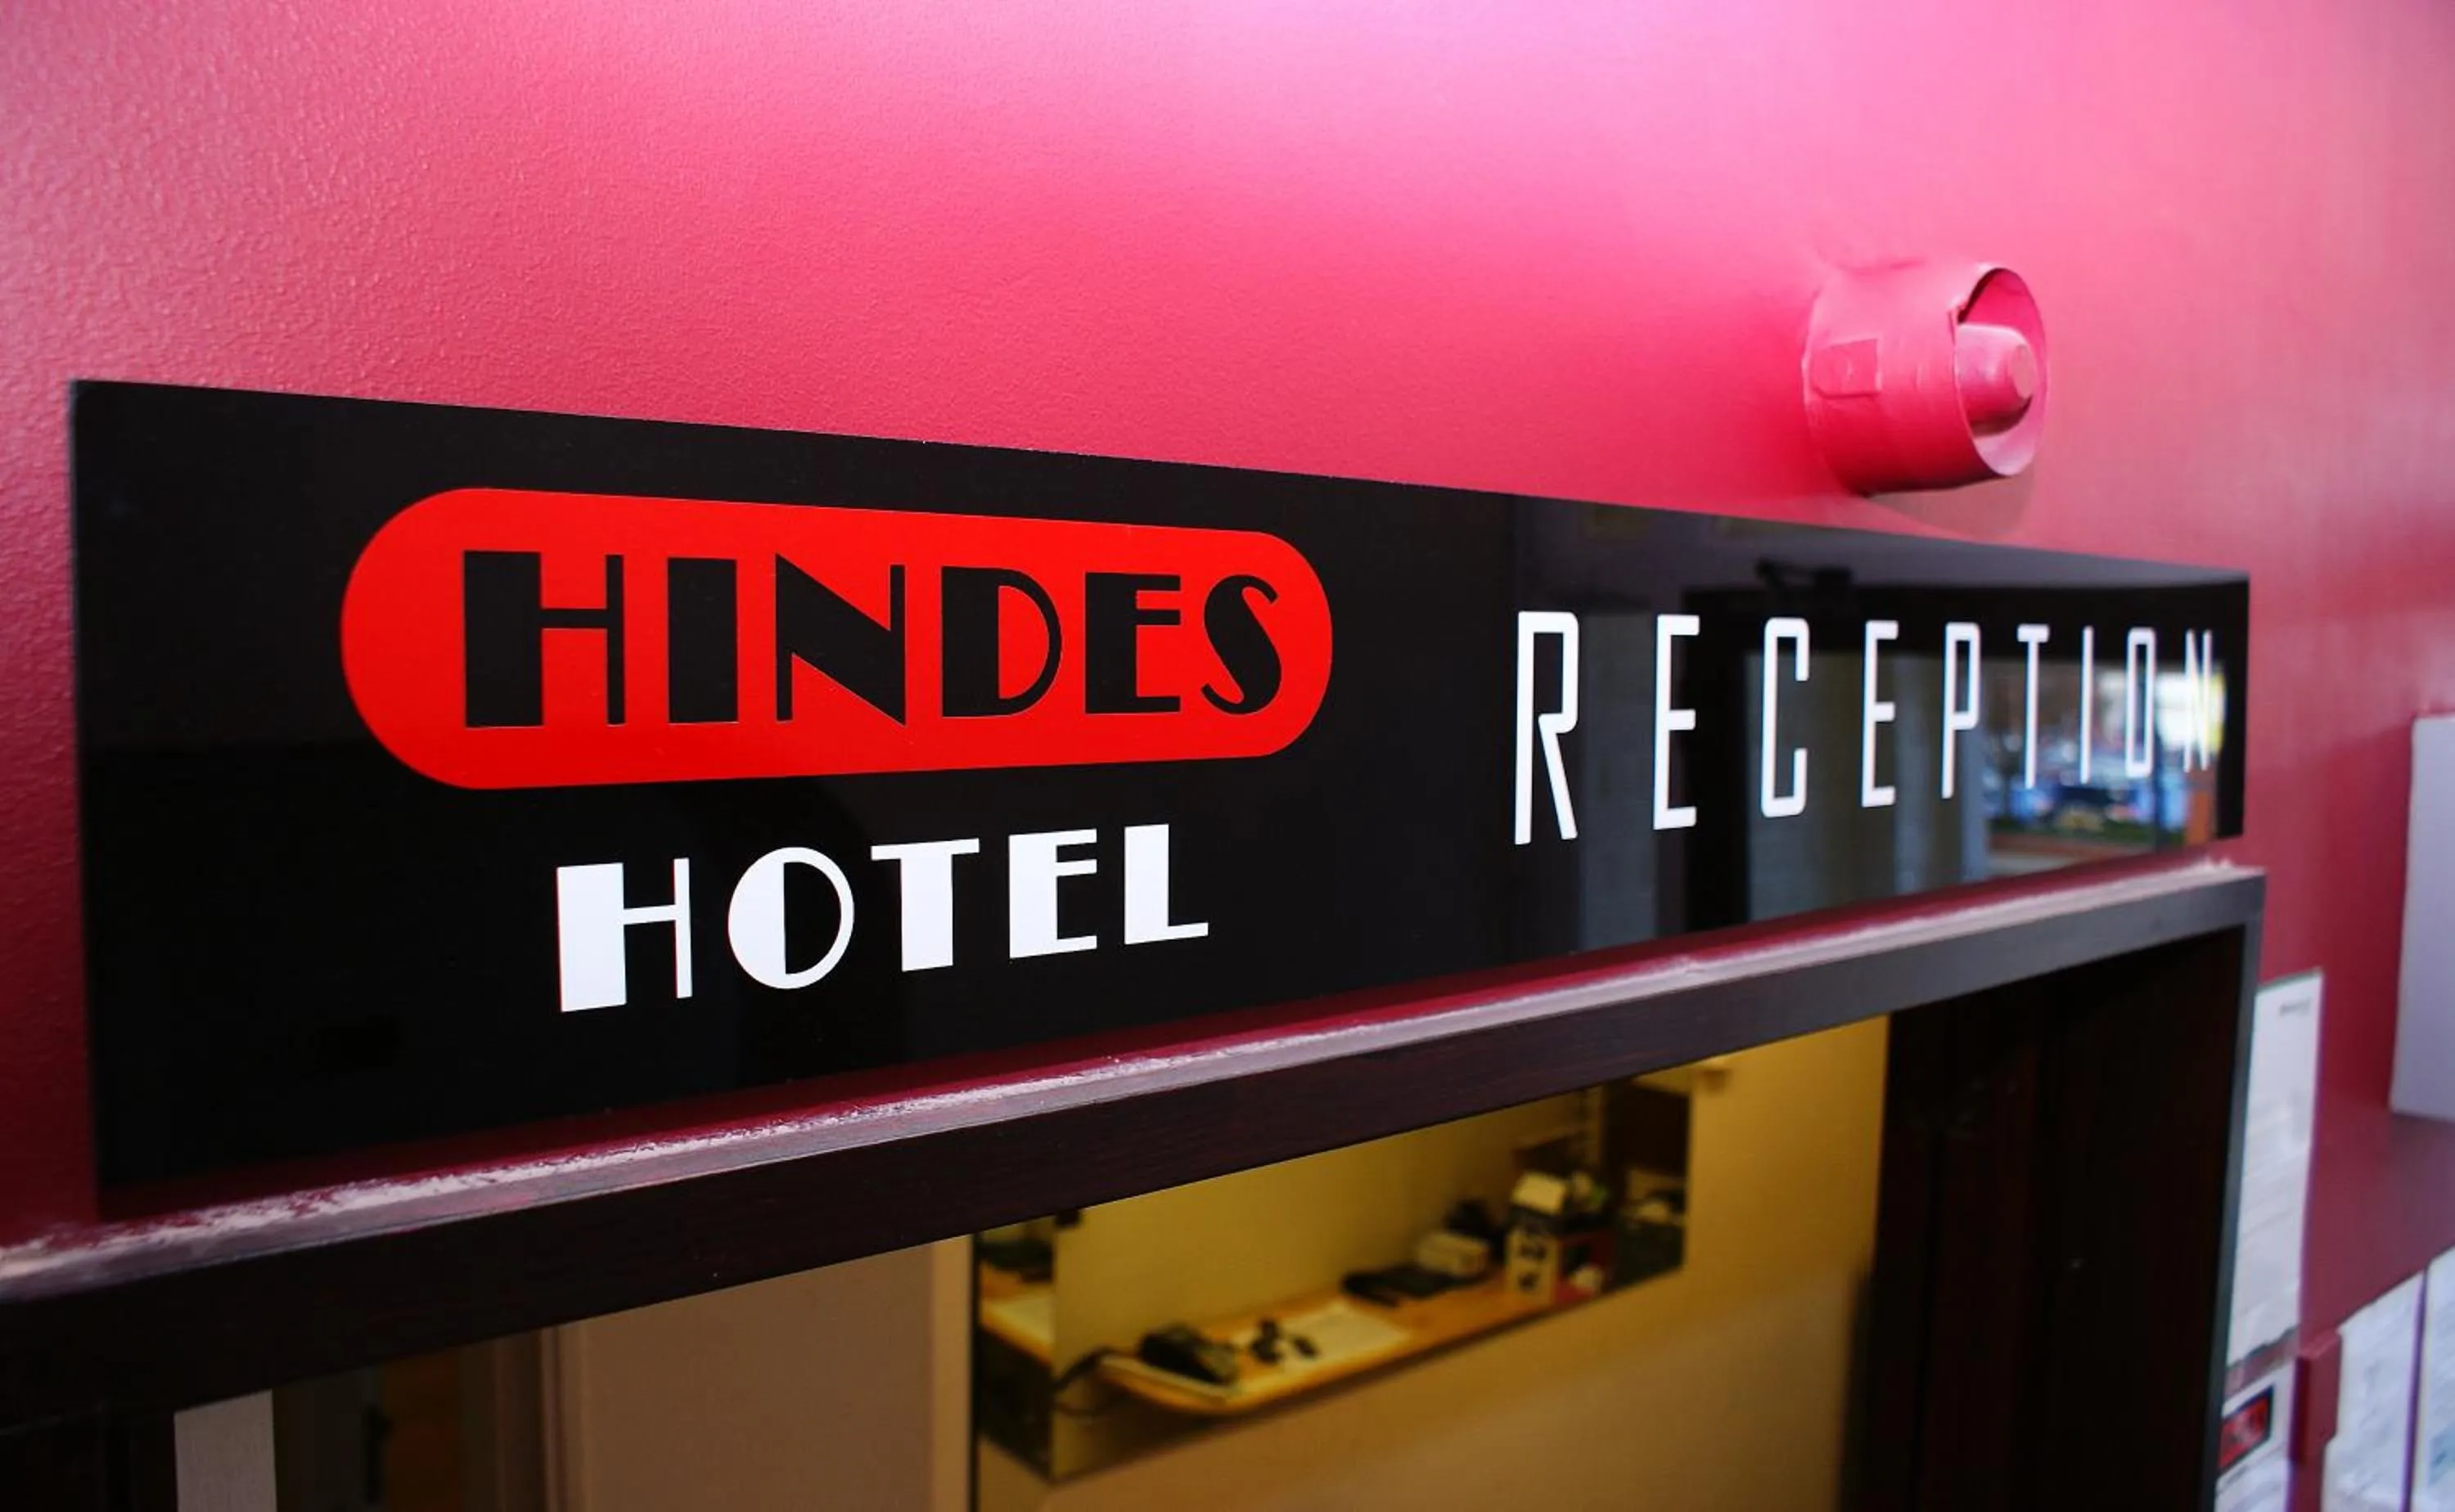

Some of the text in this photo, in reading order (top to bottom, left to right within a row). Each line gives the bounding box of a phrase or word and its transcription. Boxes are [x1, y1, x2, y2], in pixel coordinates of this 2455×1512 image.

[463, 550, 1282, 728] HINDES
[1515, 610, 2214, 844] RECEPTION
[556, 824, 1209, 1012] HOTEL
